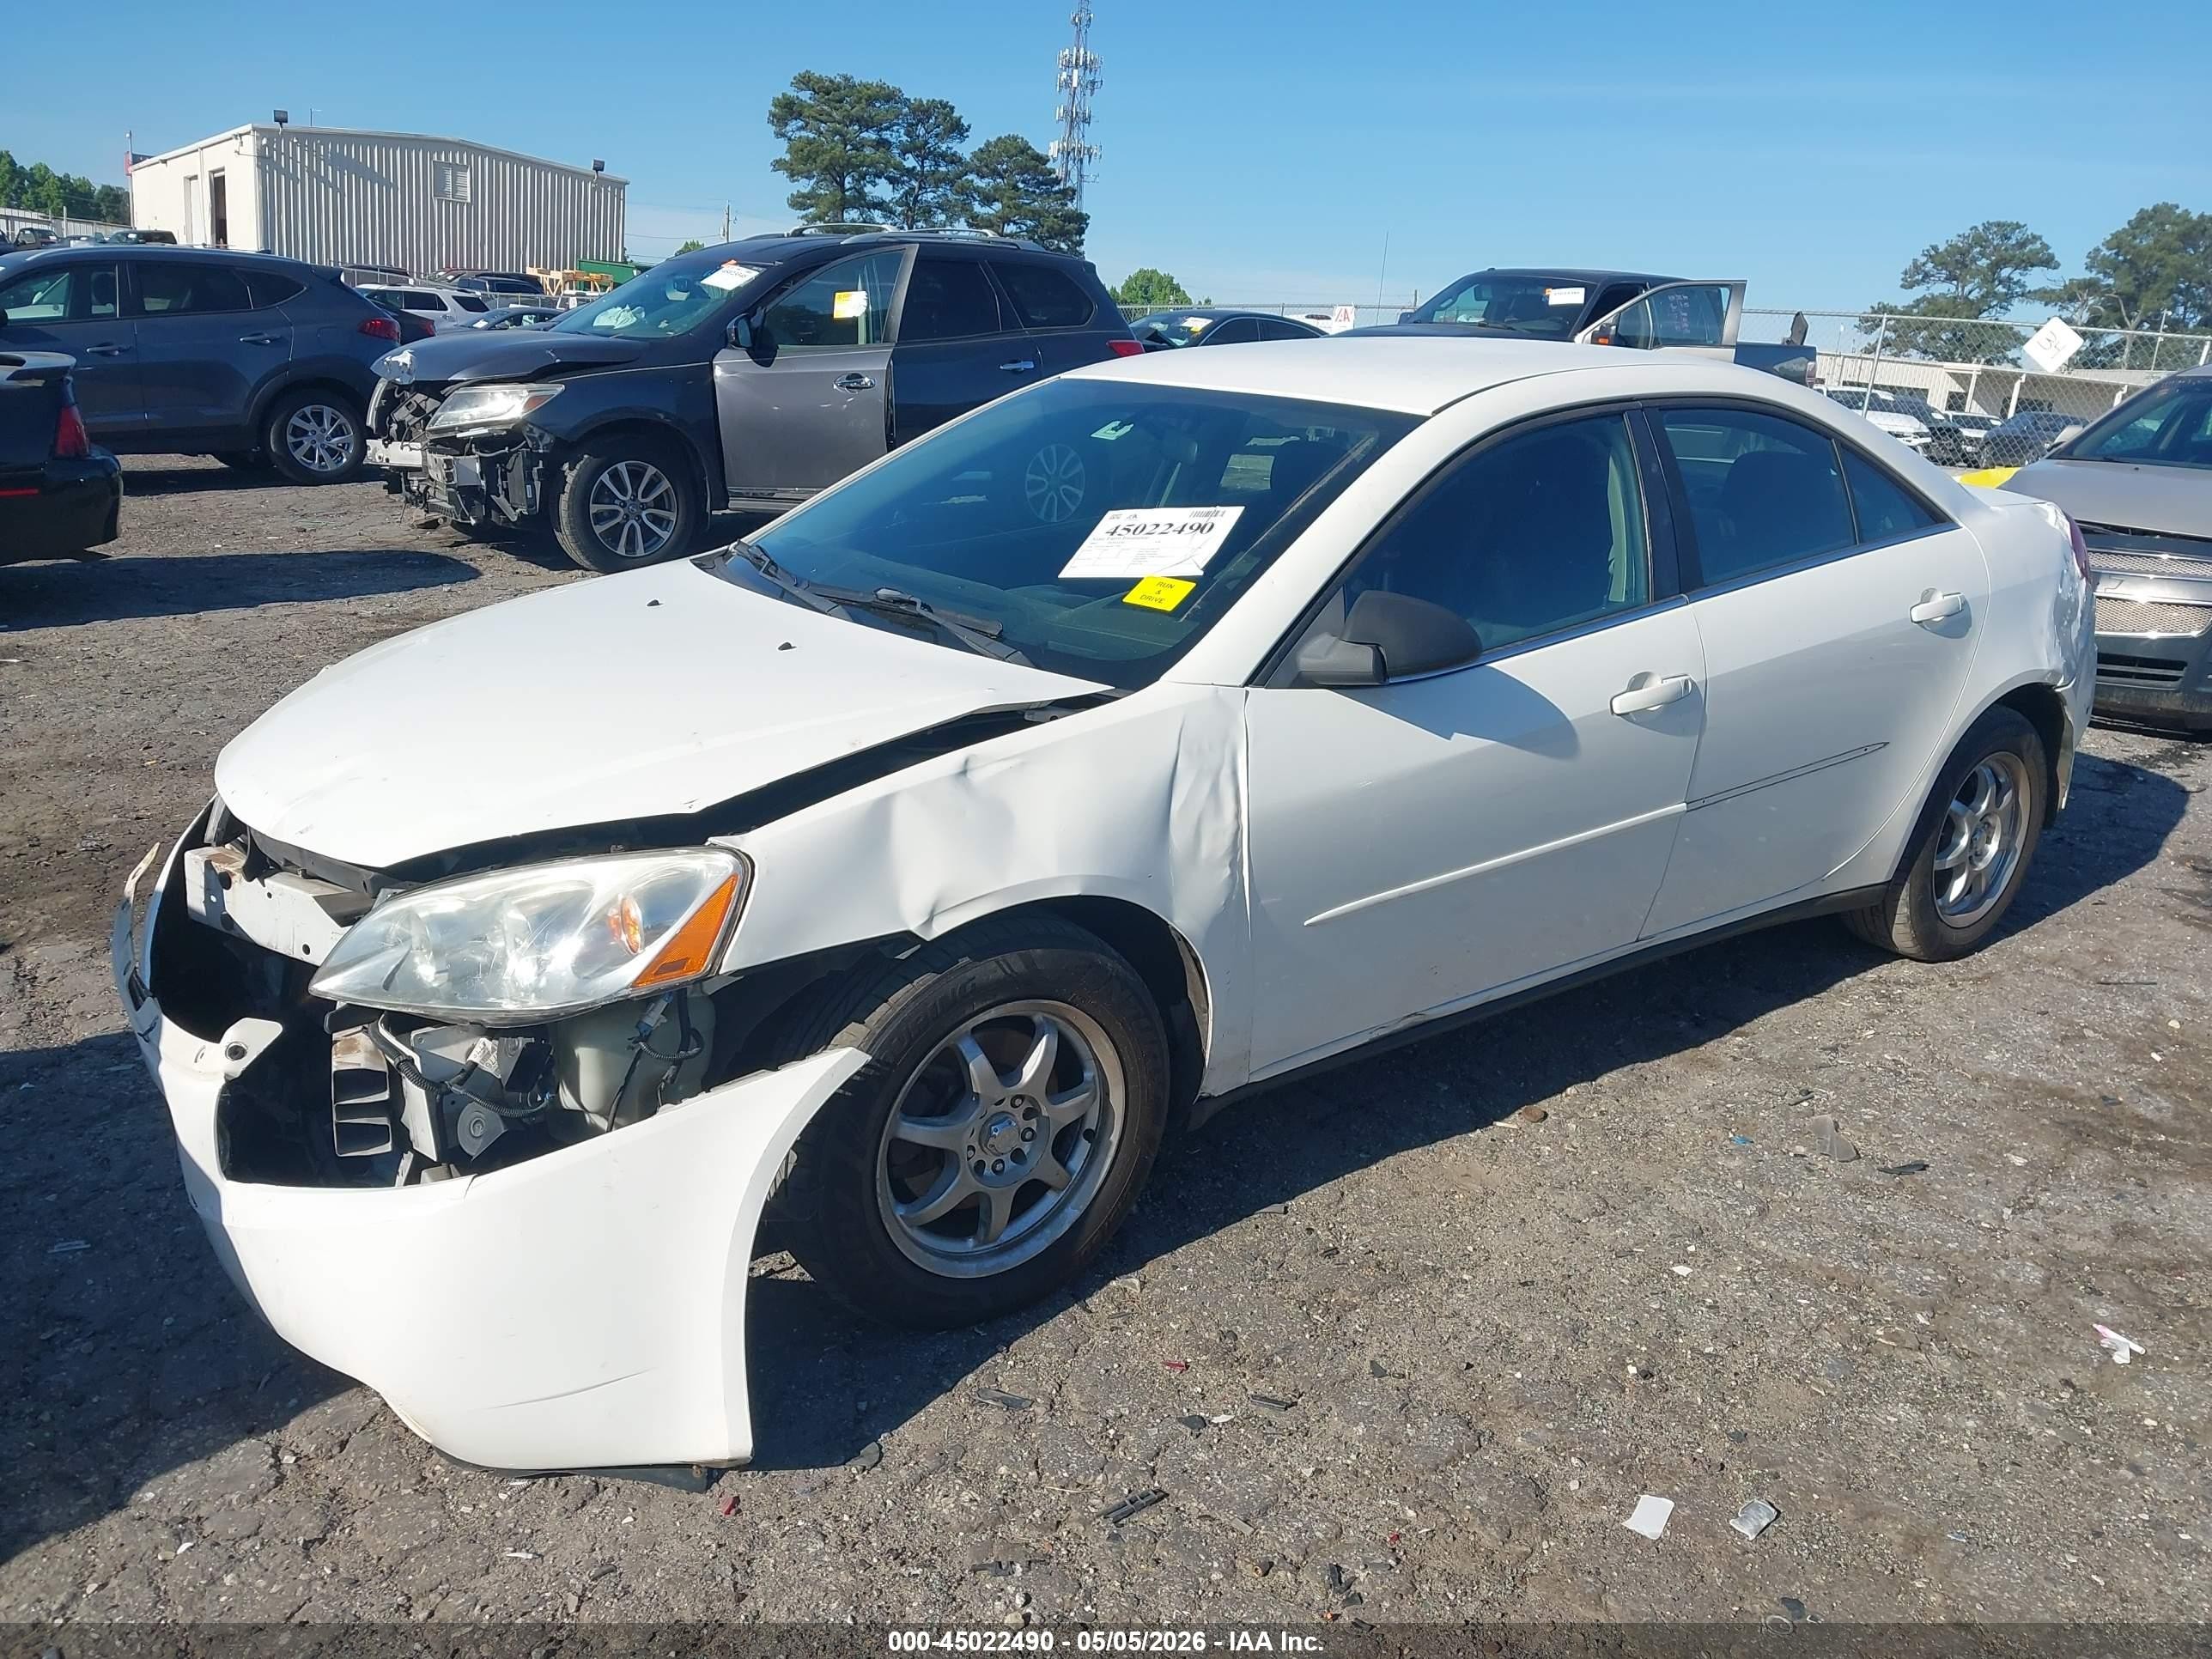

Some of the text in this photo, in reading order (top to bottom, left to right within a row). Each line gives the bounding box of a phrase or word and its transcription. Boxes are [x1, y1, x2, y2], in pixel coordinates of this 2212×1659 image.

[1104, 521, 1215, 538] 45022490
[1156, 580, 1176, 590] RUN
[1139, 594, 1166, 605] DRIVE
